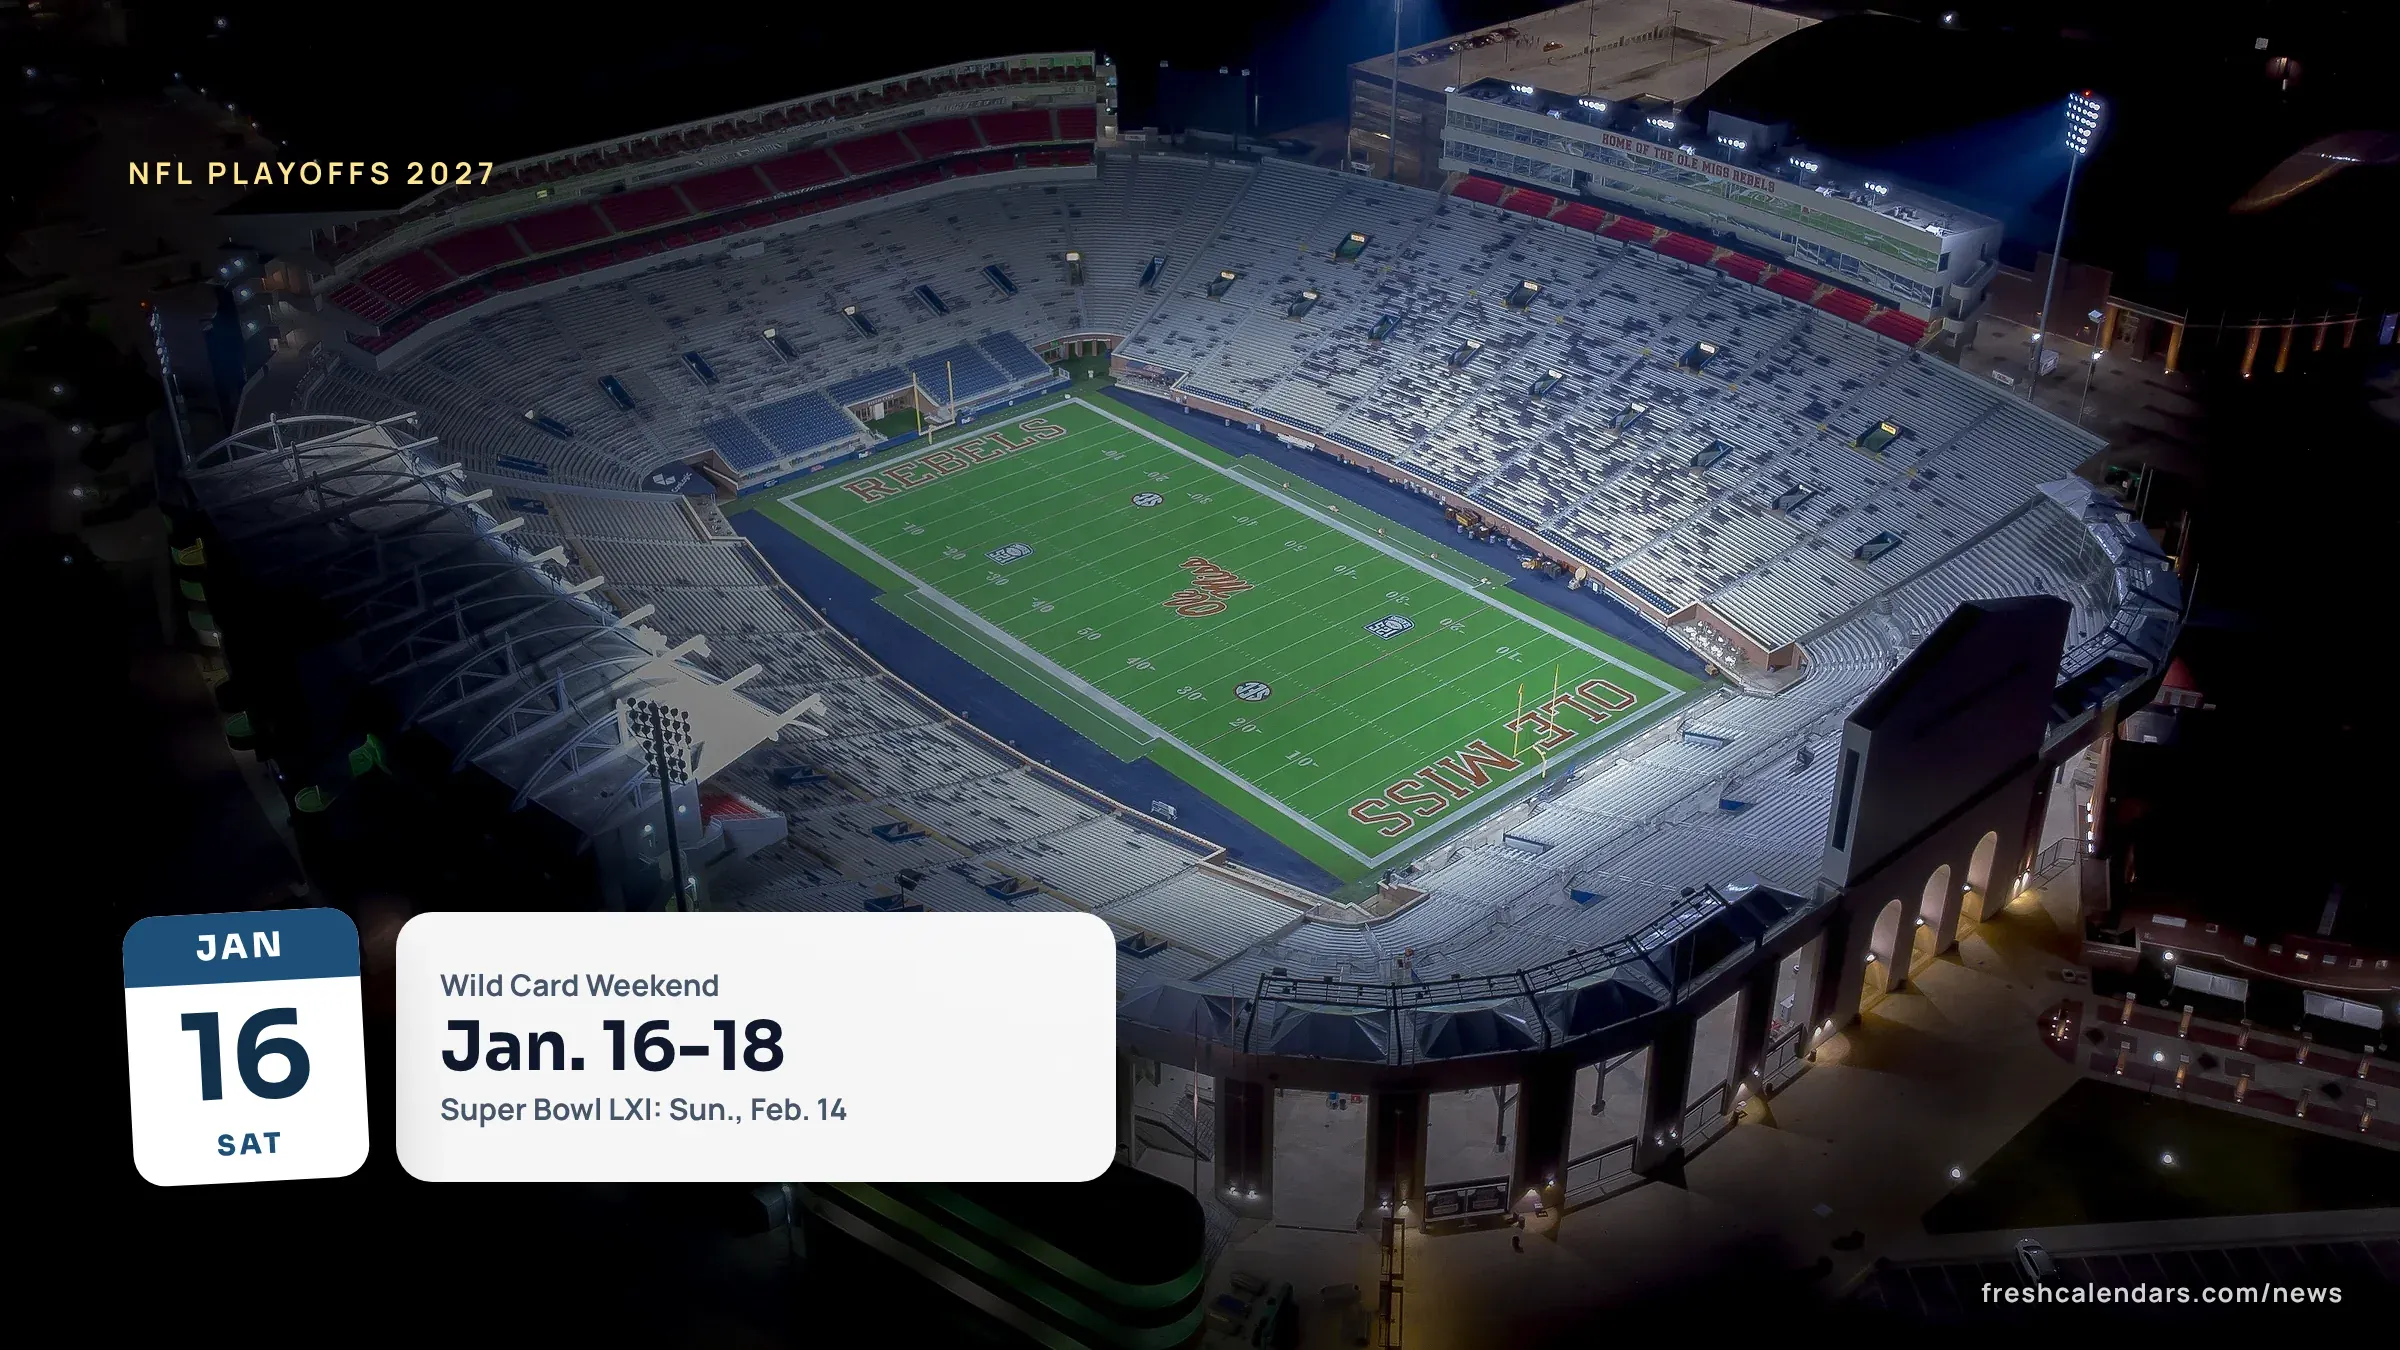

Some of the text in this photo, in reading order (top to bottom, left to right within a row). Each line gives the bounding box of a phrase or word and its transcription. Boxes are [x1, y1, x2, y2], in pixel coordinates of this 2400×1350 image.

[1602, 133, 1776, 193] HOME OF THE OLE MISS REBELS
[840, 418, 1067, 503] REBELS
[1178, 556, 1255, 600] Miss
[1162, 589, 1228, 618] Ole
[1385, 590, 1410, 604] 30
[1439, 618, 1466, 632] 20
[1077, 627, 1102, 641] 50
[1496, 646, 1523, 661] 10
[1126, 656, 1151, 671] 40
[1176, 685, 1201, 701] 30
[1228, 717, 1257, 733] 20
[1284, 749, 1314, 767] 10
[1347, 679, 1638, 837] OLE MISS
